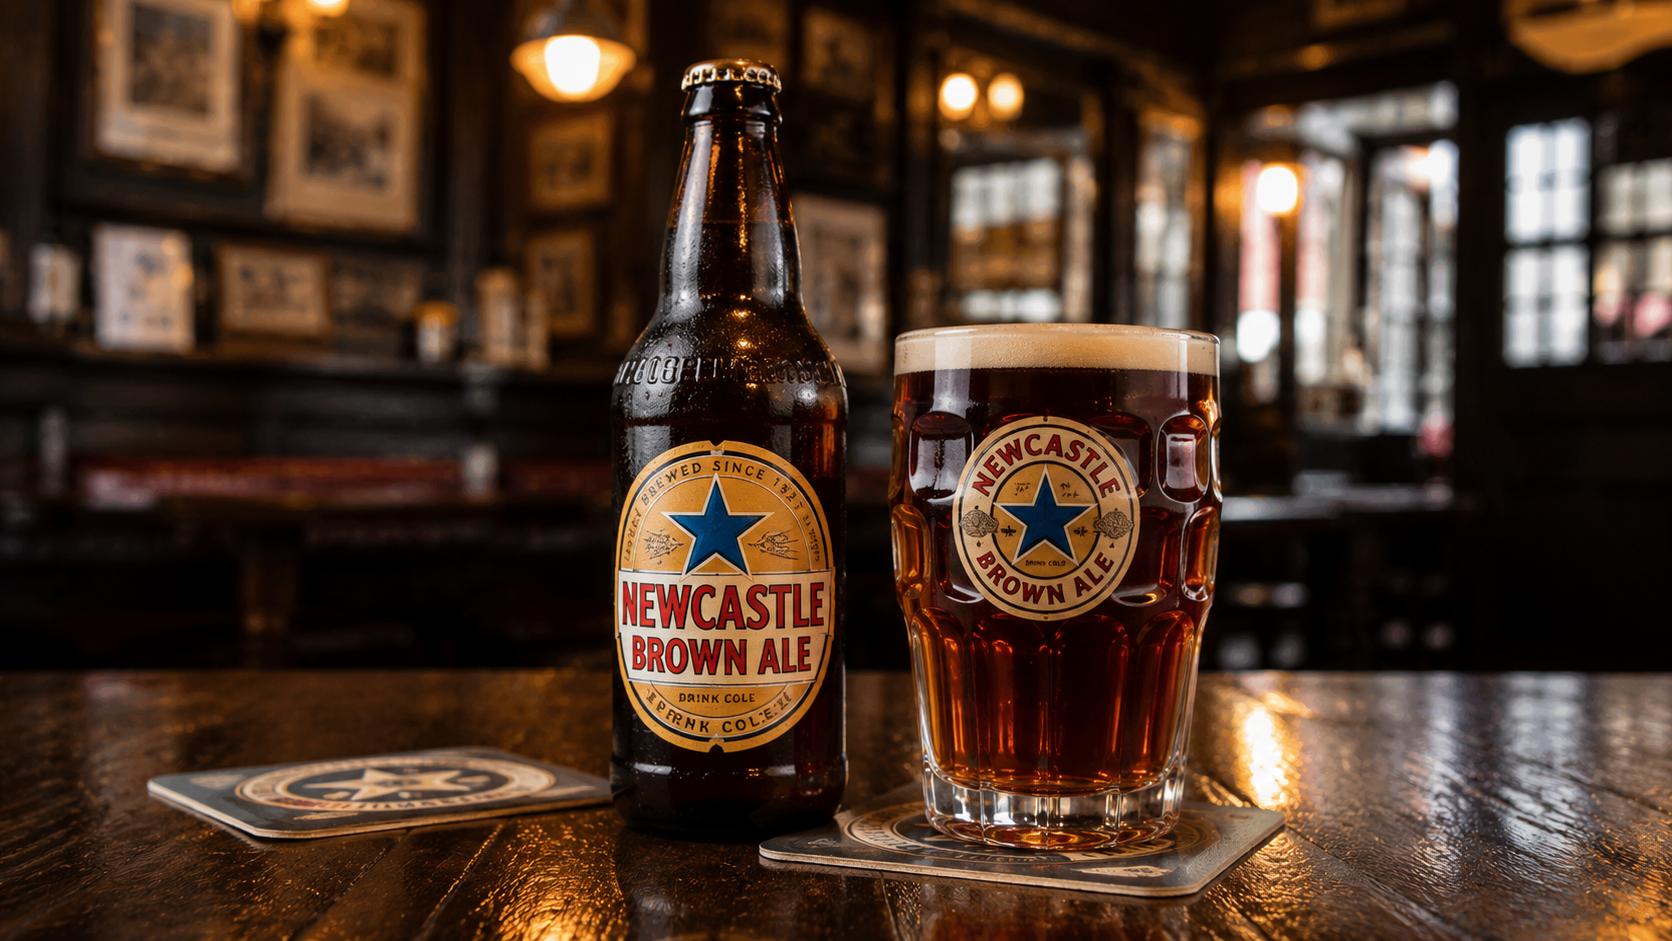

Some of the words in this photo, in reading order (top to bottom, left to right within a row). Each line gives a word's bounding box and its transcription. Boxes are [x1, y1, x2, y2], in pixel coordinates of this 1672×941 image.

[712, 459, 766, 480] SINCE
[972, 433, 1121, 499] NEWCASTLE
[976, 551, 1066, 605] BROWN
[1075, 551, 1115, 598] ALE
[622, 580, 825, 631] NEWCASTLE
[631, 634, 748, 676] BROWN
[757, 635, 812, 675] ALE
[678, 692, 720, 704] DRINK
[723, 692, 756, 704] COLE
